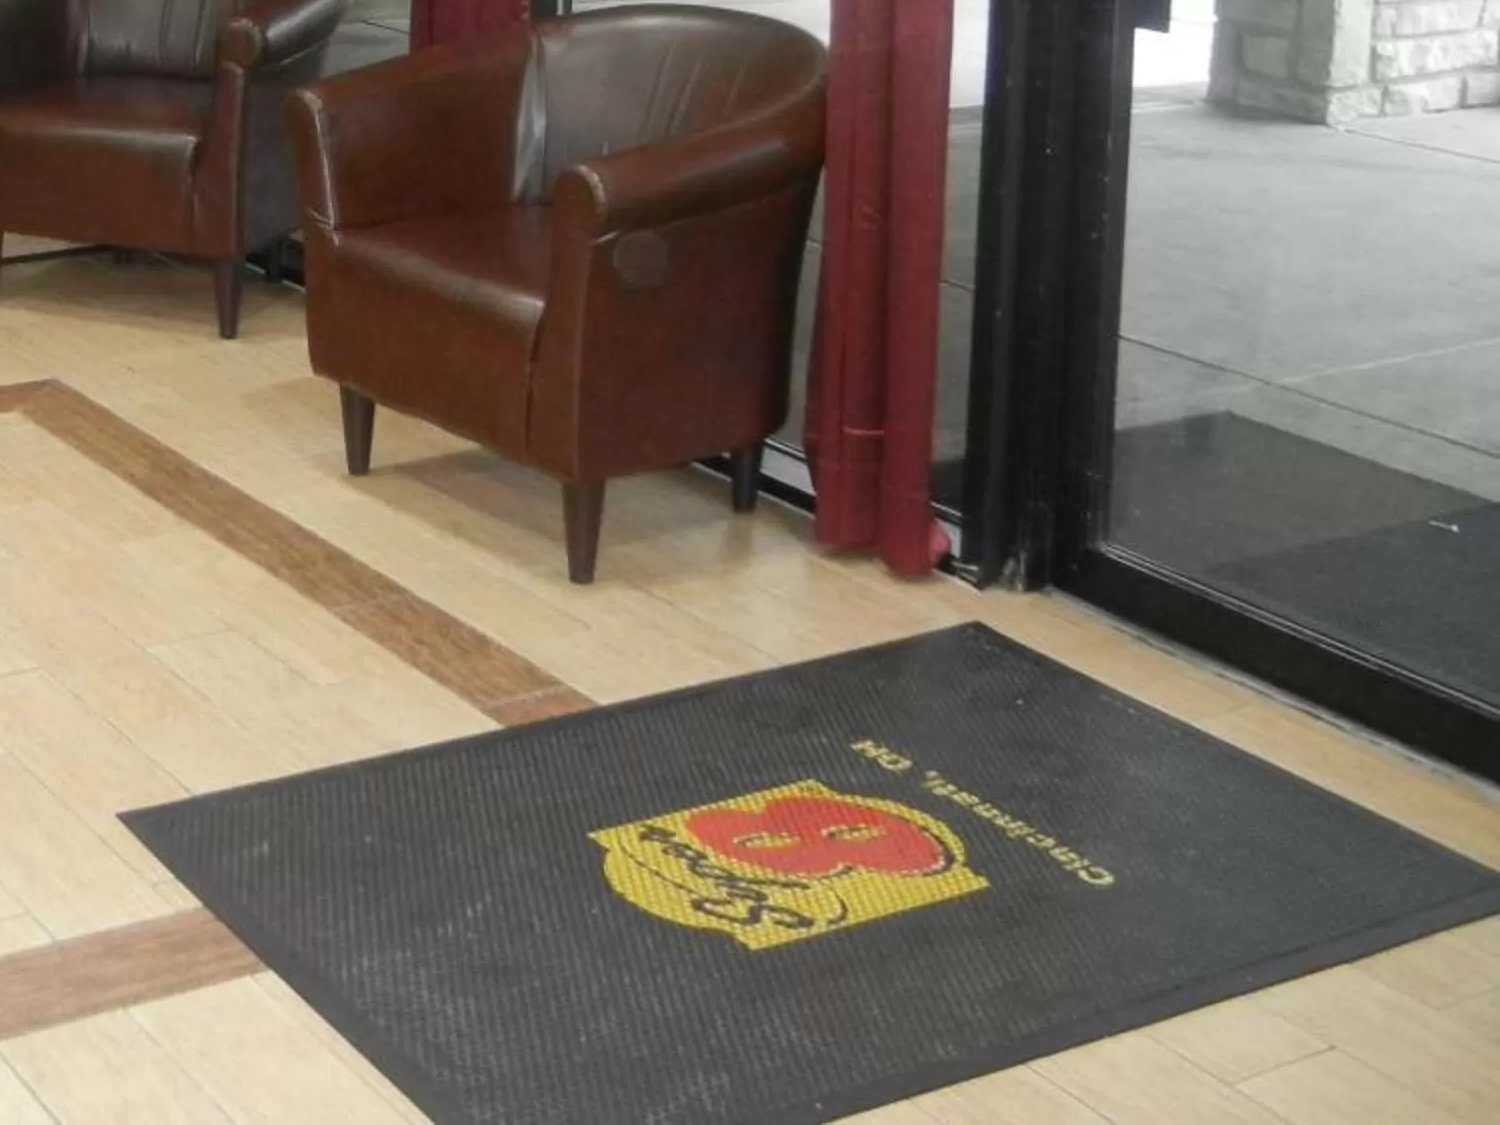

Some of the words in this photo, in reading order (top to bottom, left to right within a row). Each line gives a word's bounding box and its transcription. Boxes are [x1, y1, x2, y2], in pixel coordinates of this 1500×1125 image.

[848, 738, 914, 772] OH
[638, 823, 816, 931] Super
[683, 793, 957, 880] 8
[920, 770, 1116, 887] Cincinnati,
